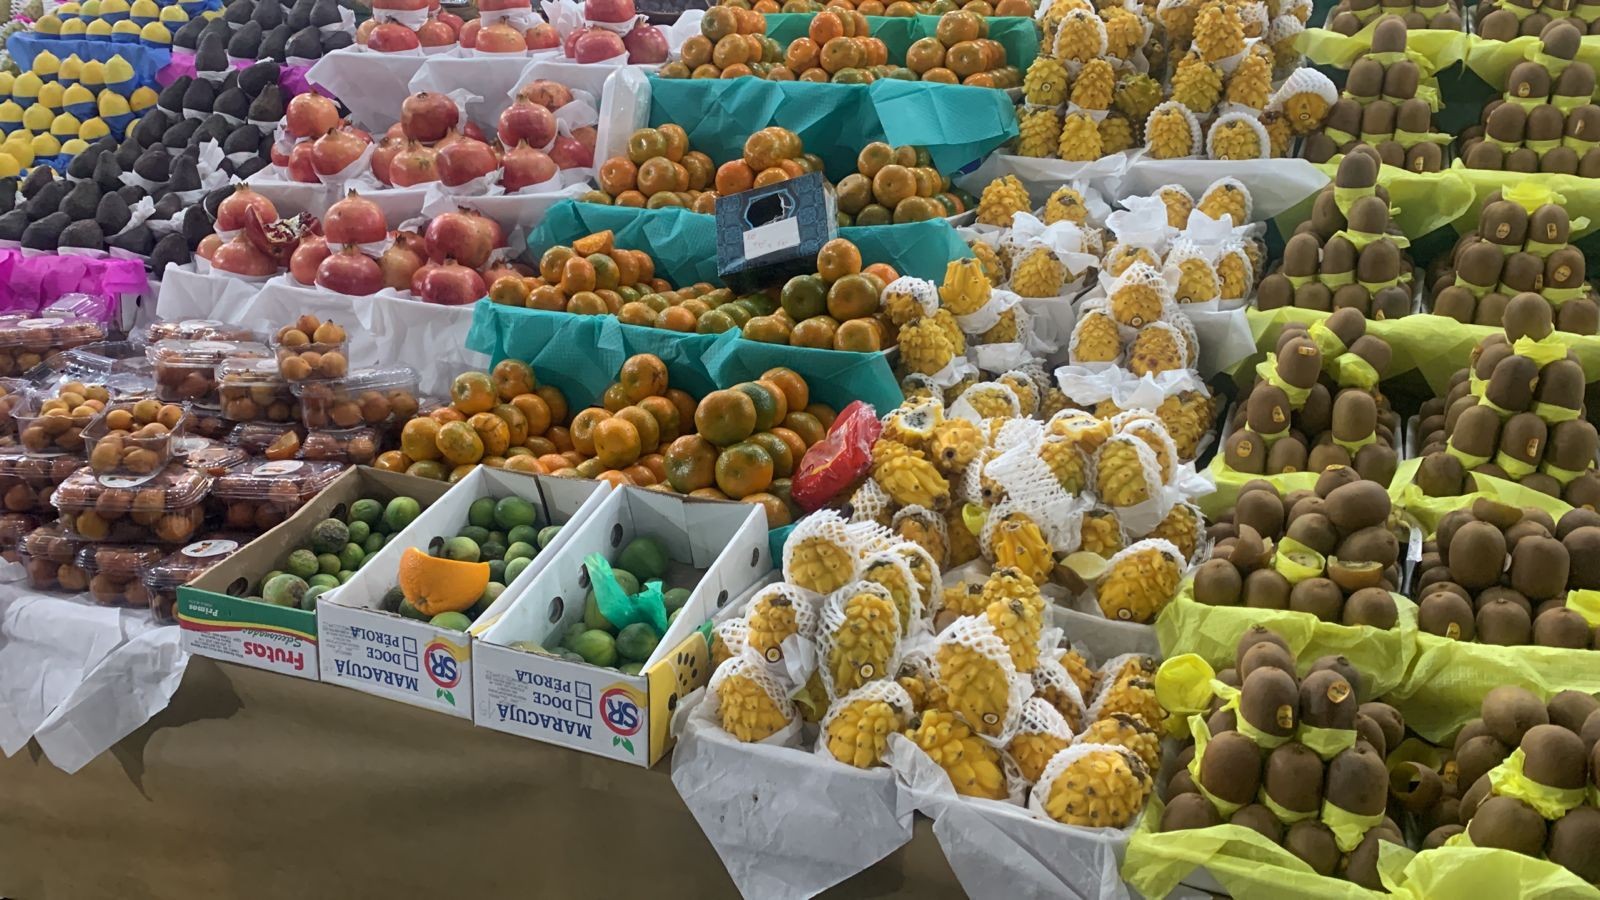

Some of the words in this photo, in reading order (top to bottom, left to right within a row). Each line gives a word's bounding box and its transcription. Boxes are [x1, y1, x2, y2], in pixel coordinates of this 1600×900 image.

[188, 603, 219, 617] Primos
[350, 626, 400, 648] PÉROLA
[243, 641, 304, 671] Frutas
[366, 647, 402, 665] DOCE
[430, 652, 457, 681] SR
[334, 659, 419, 691] MARACUJÁ
[515, 669, 571, 693] PÉROLA
[533, 691, 573, 712] DOCE
[606, 699, 638, 729] SR
[496, 703, 592, 740] MARACUJÁ
